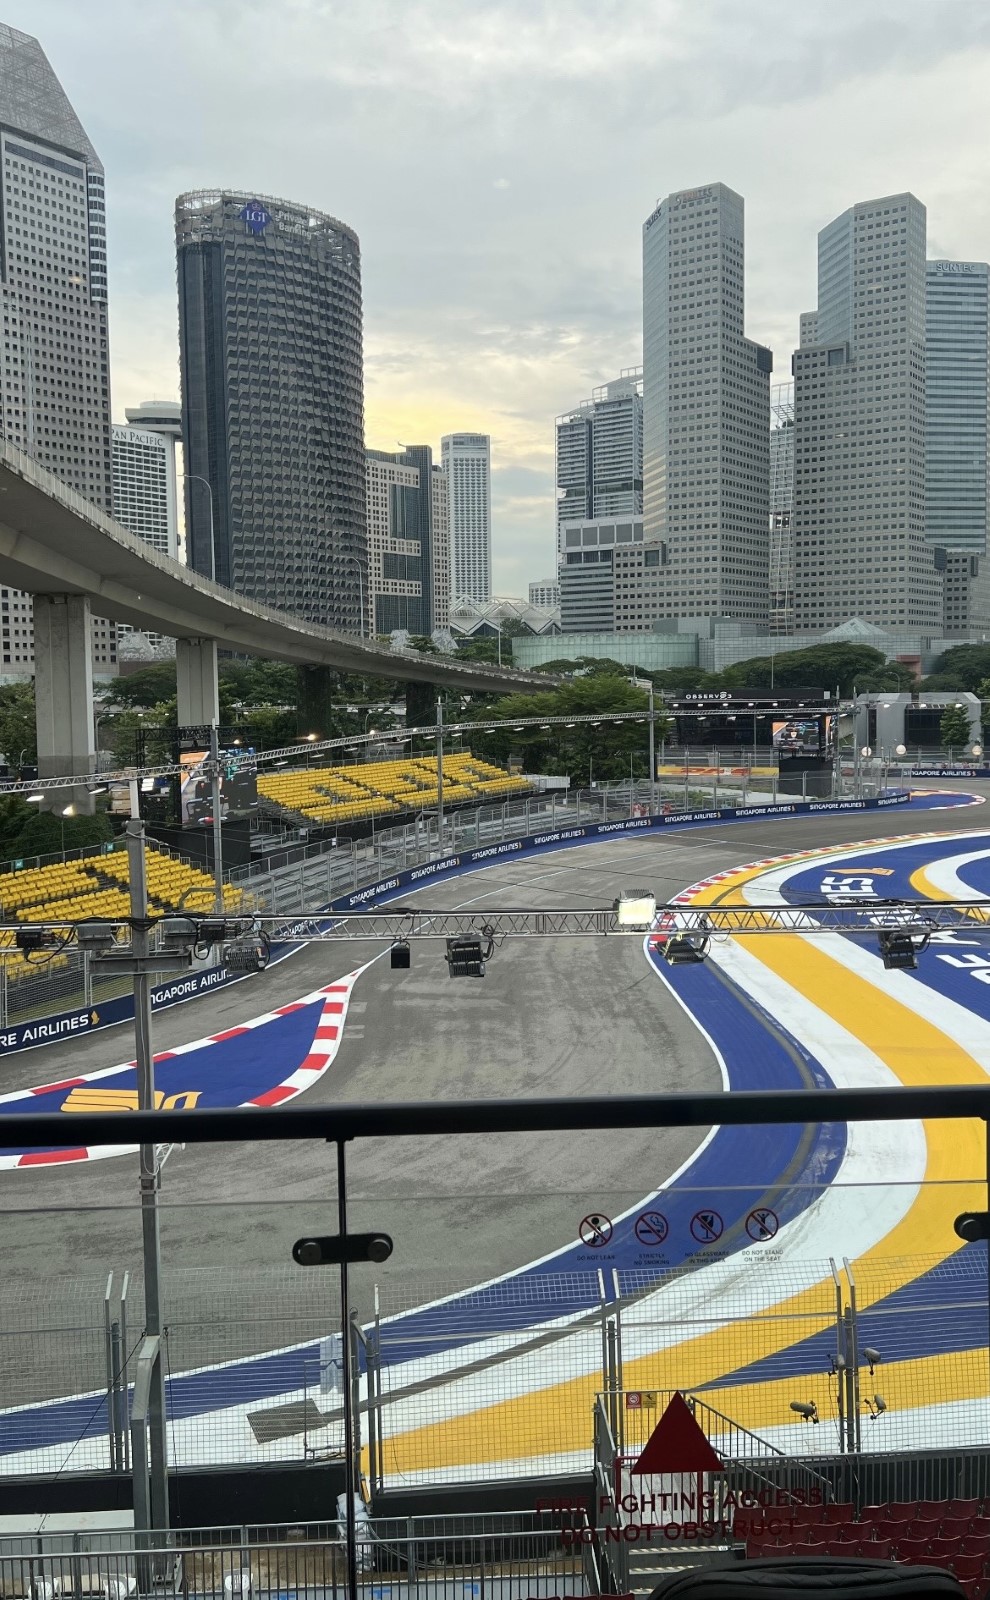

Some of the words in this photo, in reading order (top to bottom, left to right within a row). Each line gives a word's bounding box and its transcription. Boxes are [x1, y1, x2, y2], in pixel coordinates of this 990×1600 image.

[246, 210, 268, 223] LGT
[279, 222, 312, 240] Banking
[936, 262, 975, 272] SUNTEC
[130, 432, 163, 447] PACIFIC
[22, 1014, 89, 1042] AIRLINES
[536, 1496, 590, 1515] FIRE
[600, 1491, 715, 1513] FIGHTING
[723, 1487, 822, 1509] ACCESS
[561, 1526, 596, 1545] DO
[606, 1523, 656, 1543] NOT
[664, 1517, 799, 1541] OBSTRUCT
